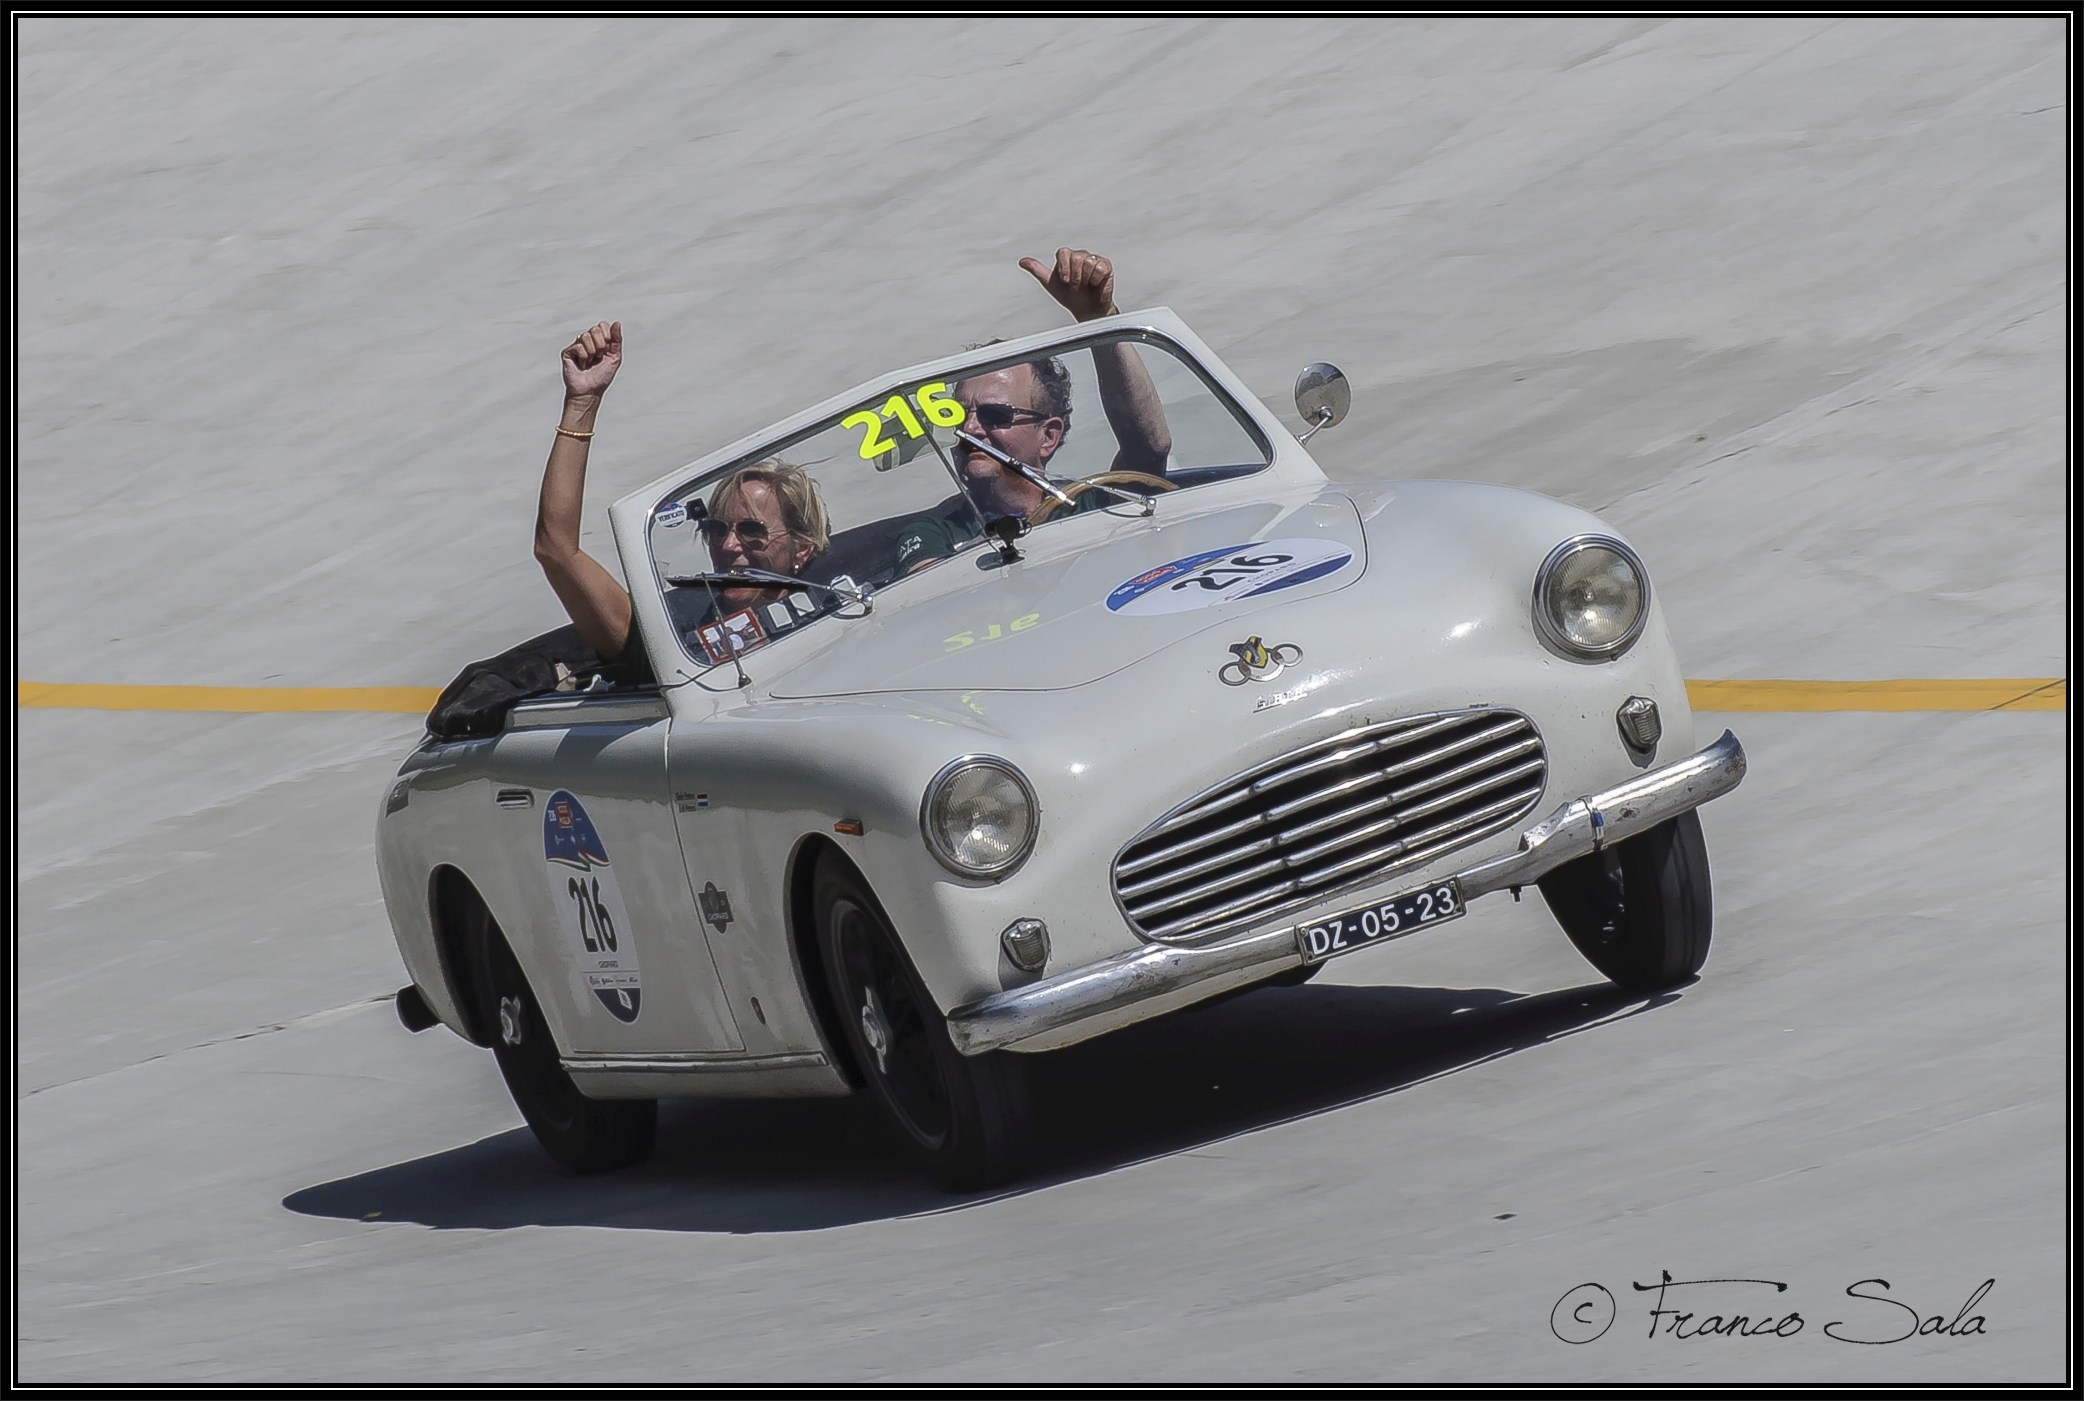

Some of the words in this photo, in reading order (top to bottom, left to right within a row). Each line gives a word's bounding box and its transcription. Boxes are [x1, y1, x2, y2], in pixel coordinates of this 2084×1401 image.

[840, 382, 966, 460] 216
[1170, 554, 1295, 592] 216
[568, 875, 618, 953] 216
[1308, 886, 1456, 956] DZ-05-23
